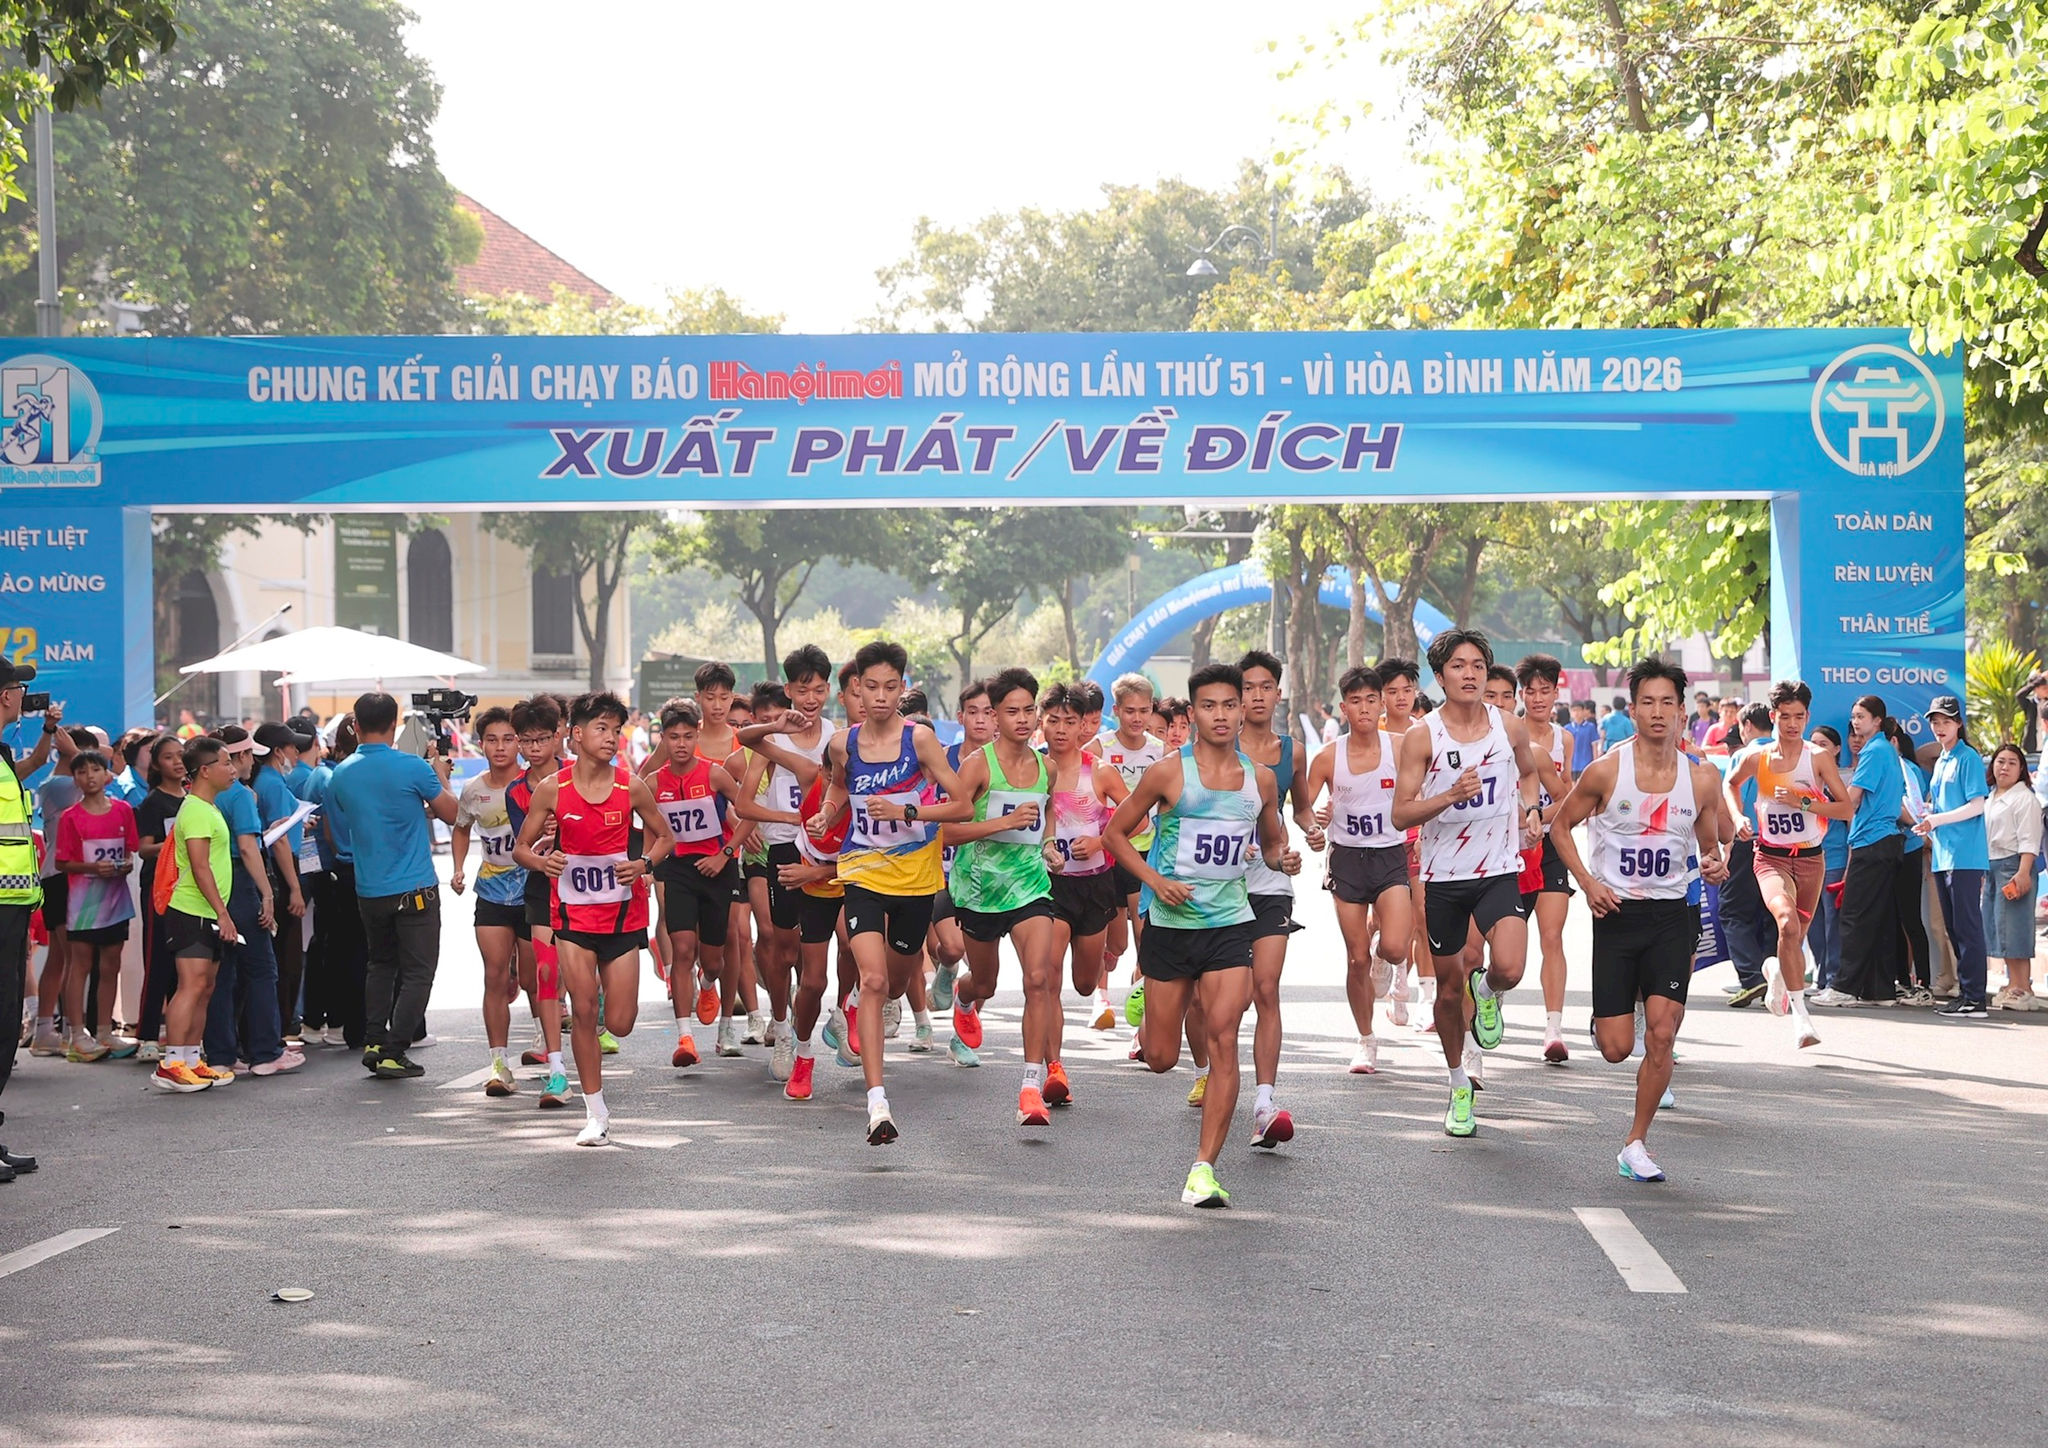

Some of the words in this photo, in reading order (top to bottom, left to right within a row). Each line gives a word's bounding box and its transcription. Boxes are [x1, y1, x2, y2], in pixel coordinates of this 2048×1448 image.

[249, 366, 365, 402] CHUNG
[379, 354, 440, 401] KẾT
[452, 353, 518, 401] GIẢI
[532, 365, 619, 408] CHẠY
[632, 357, 698, 400] BÁO
[914, 350, 968, 397] MỞ
[978, 354, 1069, 405] RỘNG
[1081, 350, 1145, 397] LẦN
[1156, 357, 1225, 397] THỨ
[1230, 360, 1264, 396] 51
[1303, 353, 1333, 395] VÌ
[1346, 352, 1412, 395] HÒA
[1423, 352, 1502, 394] BÌNH
[1514, 350, 1591, 392] NĂM
[1602, 357, 1683, 391] 2026
[2, 368, 69, 465] 51
[538, 408, 778, 478] XUẤT
[1184, 411, 1404, 473] ĐÍCH
[1860, 461, 1876, 476] HÀ
[1879, 461, 1898, 479] NỘI
[1835, 511, 1887, 531] TOÀN
[1893, 512, 1932, 531] DÂN
[47, 525, 89, 551] LIỆT
[40, 571, 106, 592] MỪNG
[1835, 561, 1870, 582] RÈN
[1876, 562, 1933, 586] LUYỆN
[1840, 613, 1889, 633] THÂN
[1895, 610, 1930, 633] THỂ
[46, 640, 94, 661] NĂM
[1821, 667, 1871, 684] THEO
[1876, 667, 1948, 684] GƯƠNG
[668, 808, 708, 834] 572
[1680, 807, 1693, 817] MB
[1767, 812, 1805, 835] 559
[1346, 813, 1383, 836] 561
[1194, 833, 1244, 866] 597
[1619, 847, 1671, 878] 596
[571, 865, 616, 893] 601
